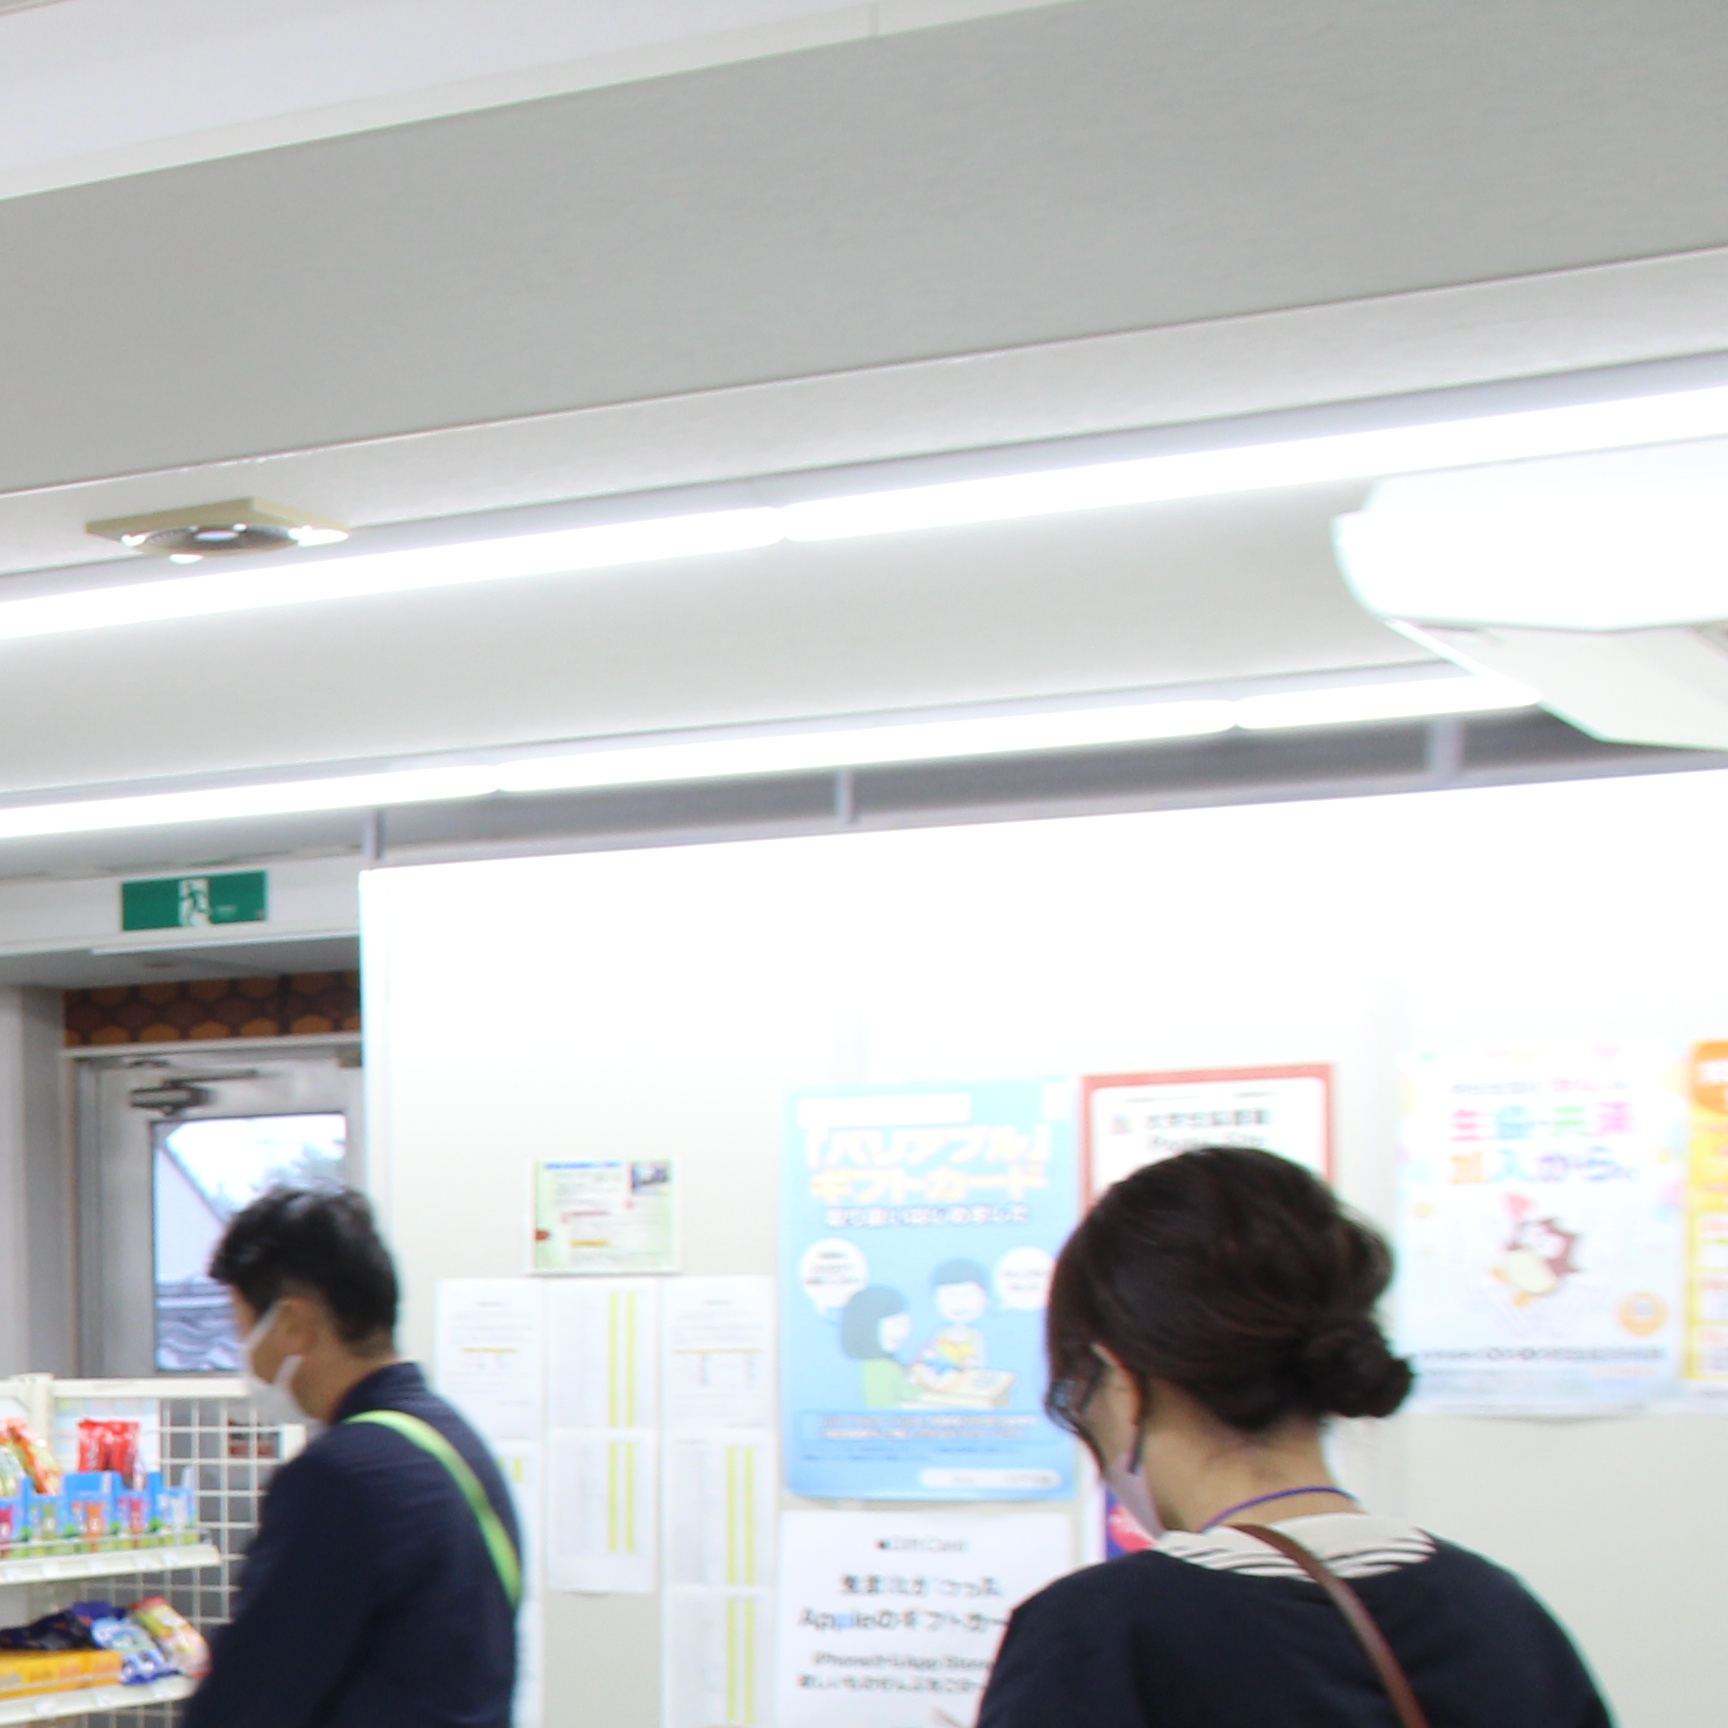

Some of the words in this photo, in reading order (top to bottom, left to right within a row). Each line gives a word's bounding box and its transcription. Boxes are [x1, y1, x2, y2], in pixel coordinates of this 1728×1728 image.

[812, 1164, 1047, 1204] ギフトカード
